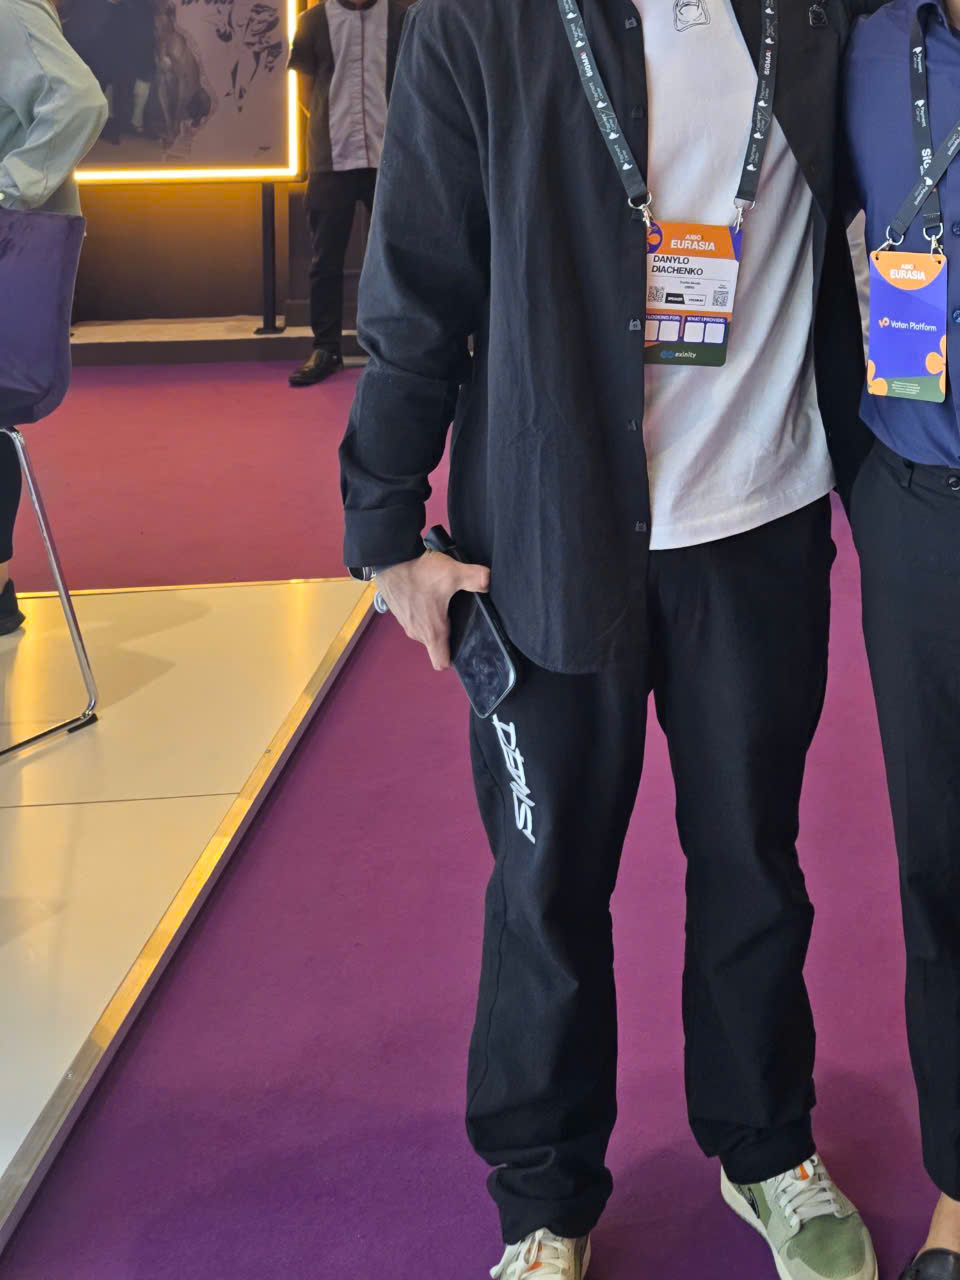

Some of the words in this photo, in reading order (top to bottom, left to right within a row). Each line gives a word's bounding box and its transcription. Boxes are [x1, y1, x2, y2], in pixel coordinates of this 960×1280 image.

[671, 240, 715, 251] EURASIA
[653, 255, 690, 265] DANYLO
[651, 265, 704, 276] DIACHENKO
[890, 269, 926, 281] EURASIA
[909, 321, 937, 332] Platform
[674, 350, 697, 359] exinity
